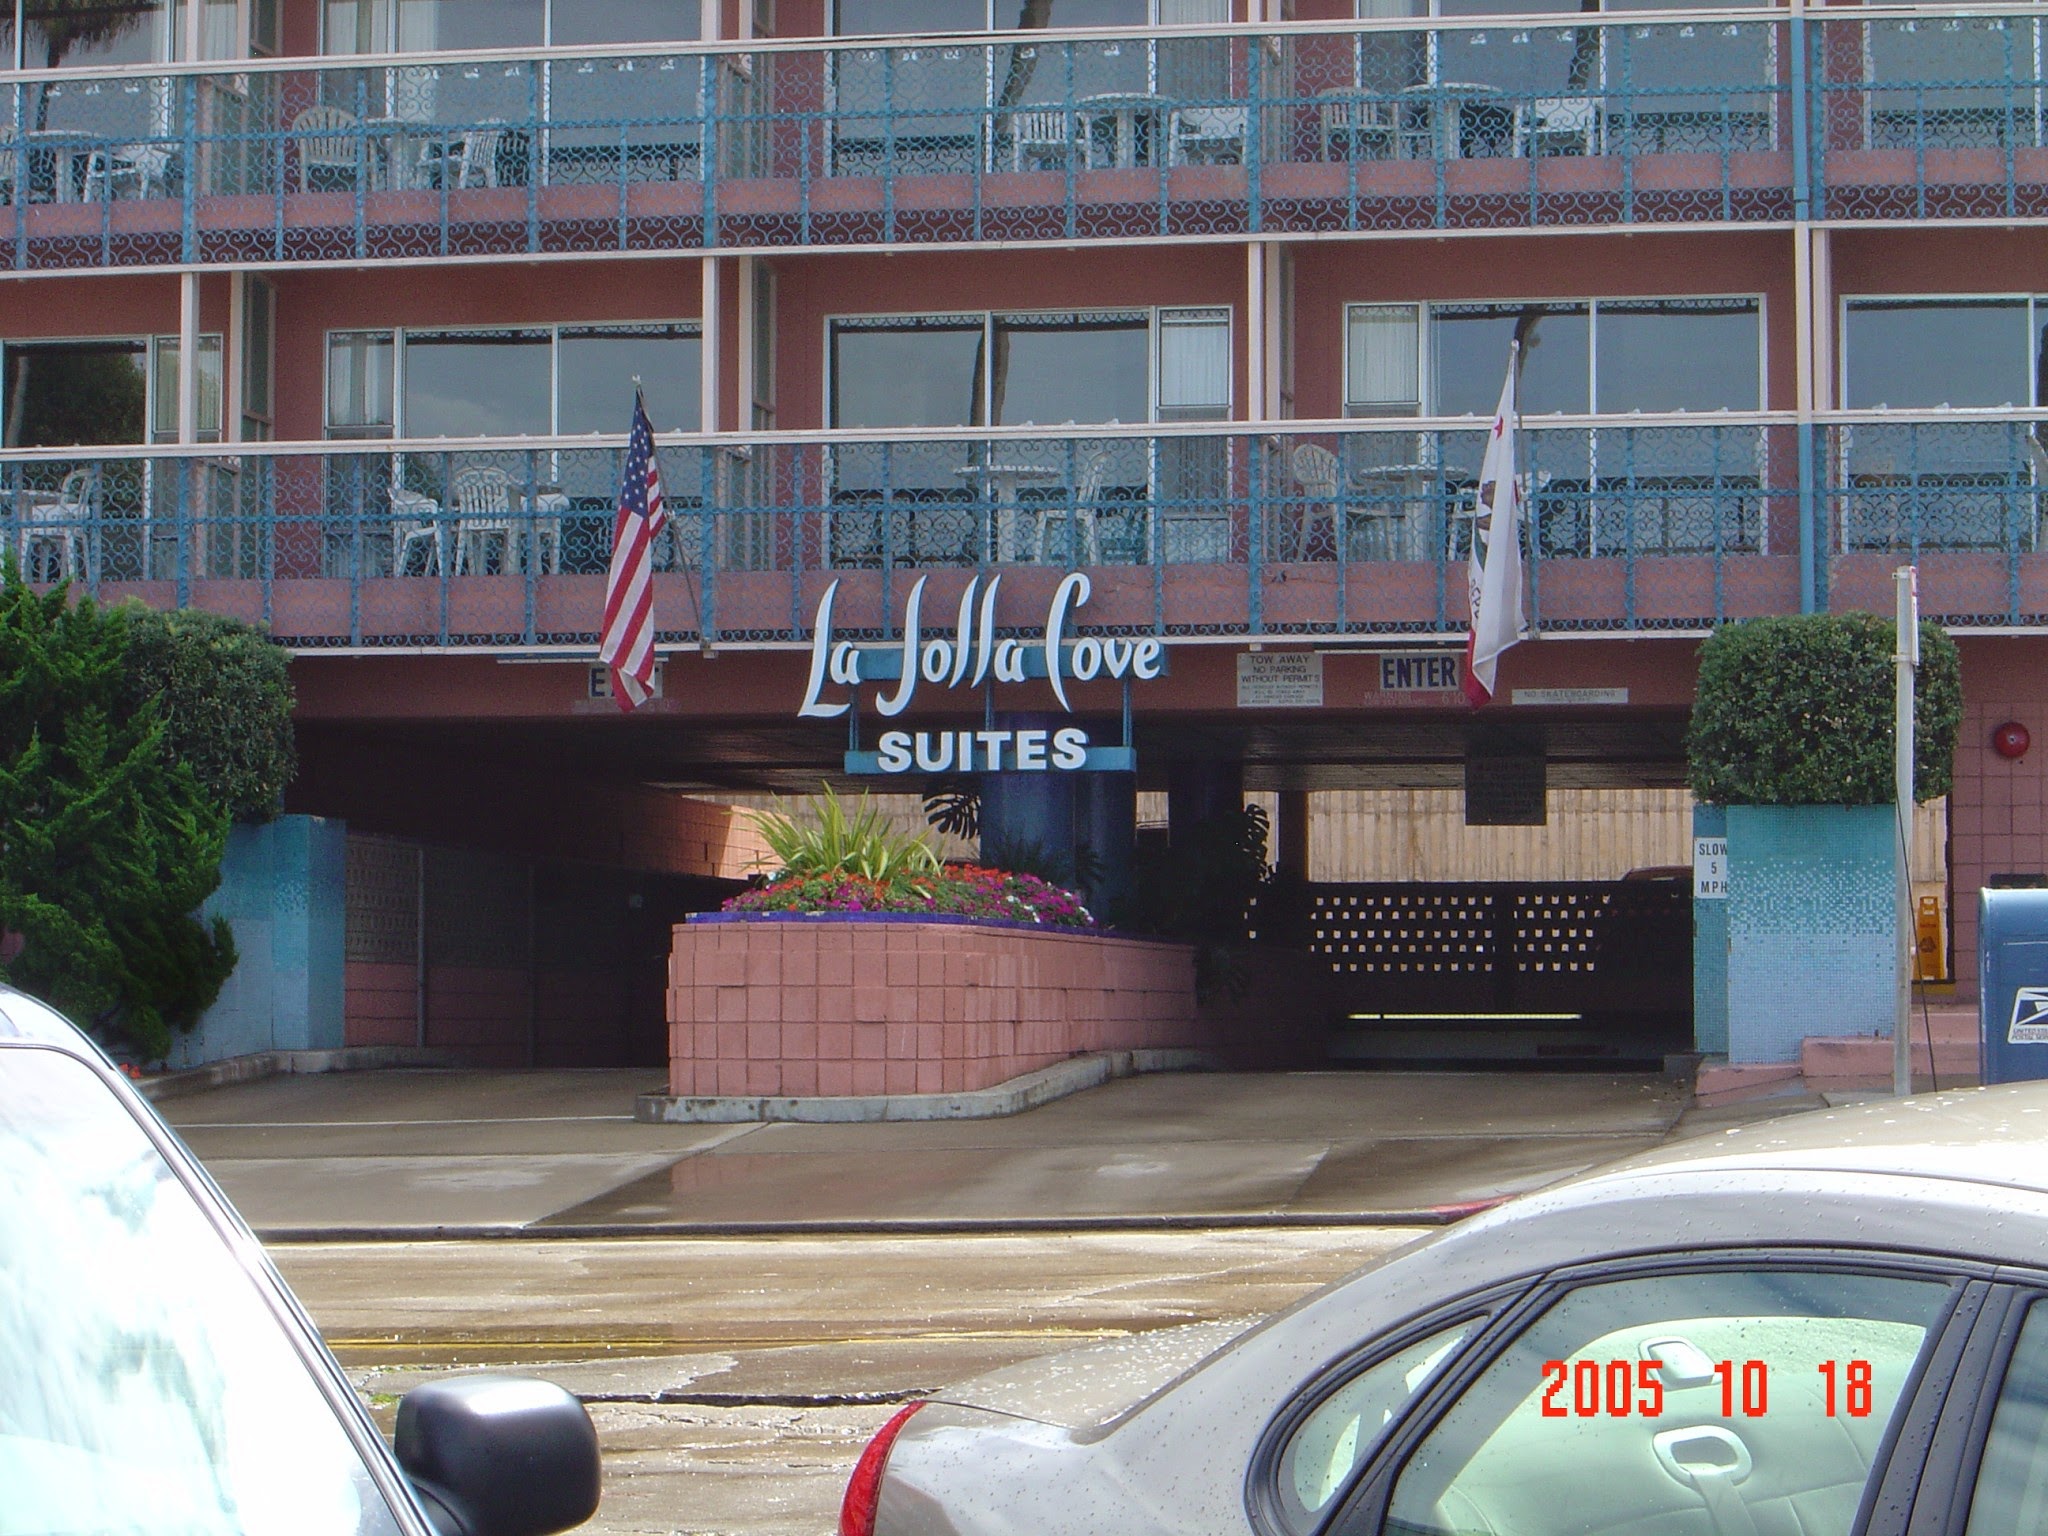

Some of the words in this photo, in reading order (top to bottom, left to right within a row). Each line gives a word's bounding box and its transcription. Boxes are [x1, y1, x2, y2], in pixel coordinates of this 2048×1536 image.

[797, 578, 861, 717] La
[875, 574, 1026, 716] Jolla
[1045, 572, 1161, 713] Cove
[1250, 655, 1273, 664] TOW
[1279, 655, 1310, 664] AWAY
[1253, 665, 1266, 674] NO
[1269, 665, 1307, 674] PARKING
[1382, 656, 1457, 689] ENTER
[1241, 674, 1278, 683] WITHOUT
[1523, 690, 1537, 698] NO
[877, 727, 1089, 773] SUITES
[1698, 843, 1728, 856] SLOW
[1710, 861, 1718, 875] 5
[1700, 880, 1728, 894] MPH
